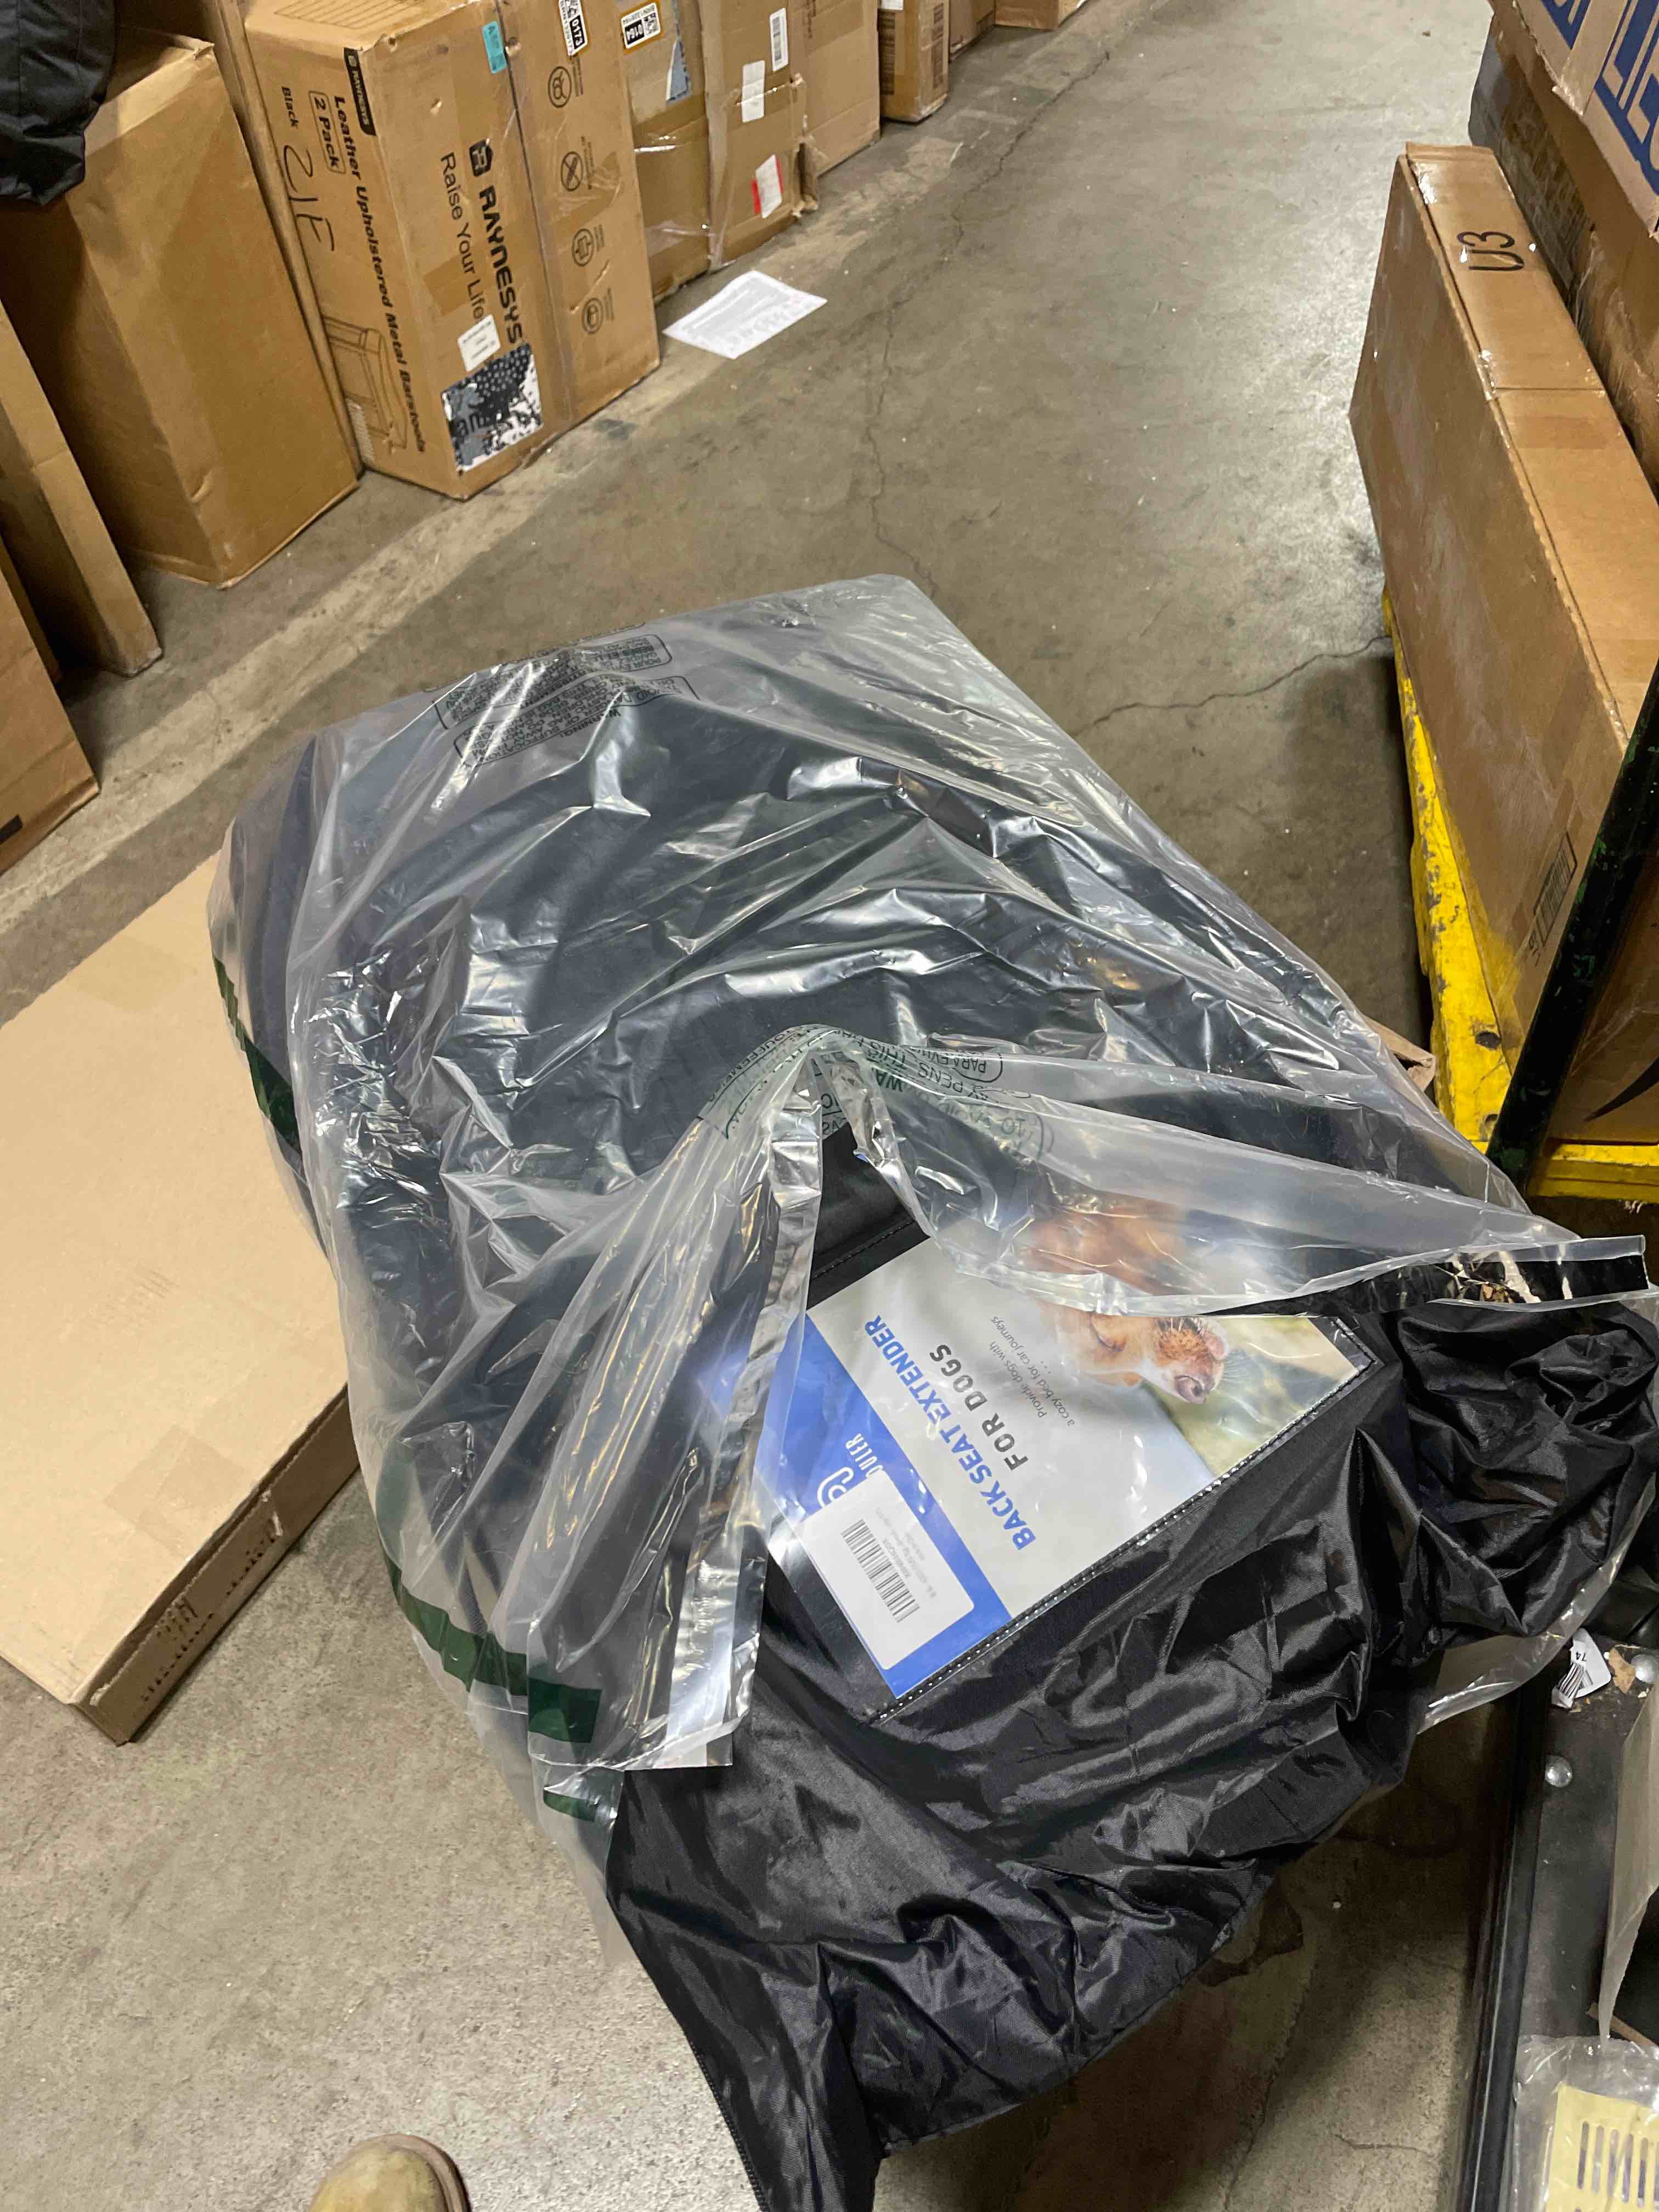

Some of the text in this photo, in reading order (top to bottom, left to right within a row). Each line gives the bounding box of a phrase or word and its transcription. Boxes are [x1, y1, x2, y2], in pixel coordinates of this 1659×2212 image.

[282, 86, 298, 128] Black
[314, 97, 340, 168] 2 Pack
[334, 95, 362, 180] Leather
[356, 185, 393, 308] Upholstered
[386, 313, 407, 365] Metal
[441, 152, 462, 220] Raise
[457, 223, 476, 274] Your
[467, 279, 486, 320] Life
[479, 185, 523, 344] RAYNESYS
[991, 1316, 1024, 1350] journeys
[1017, 1352, 1030, 1364] car
[929, 1344, 1029, 1471] FOR DOGS
[990, 1341, 1047, 1418] Provide dogs with
[1027, 1365, 1040, 1379] for
[1037, 1379, 1053, 1398] bed
[865, 1316, 1036, 1550] BACK SEAT EXTENDER
[1052, 1398, 1069, 1418] cozy
